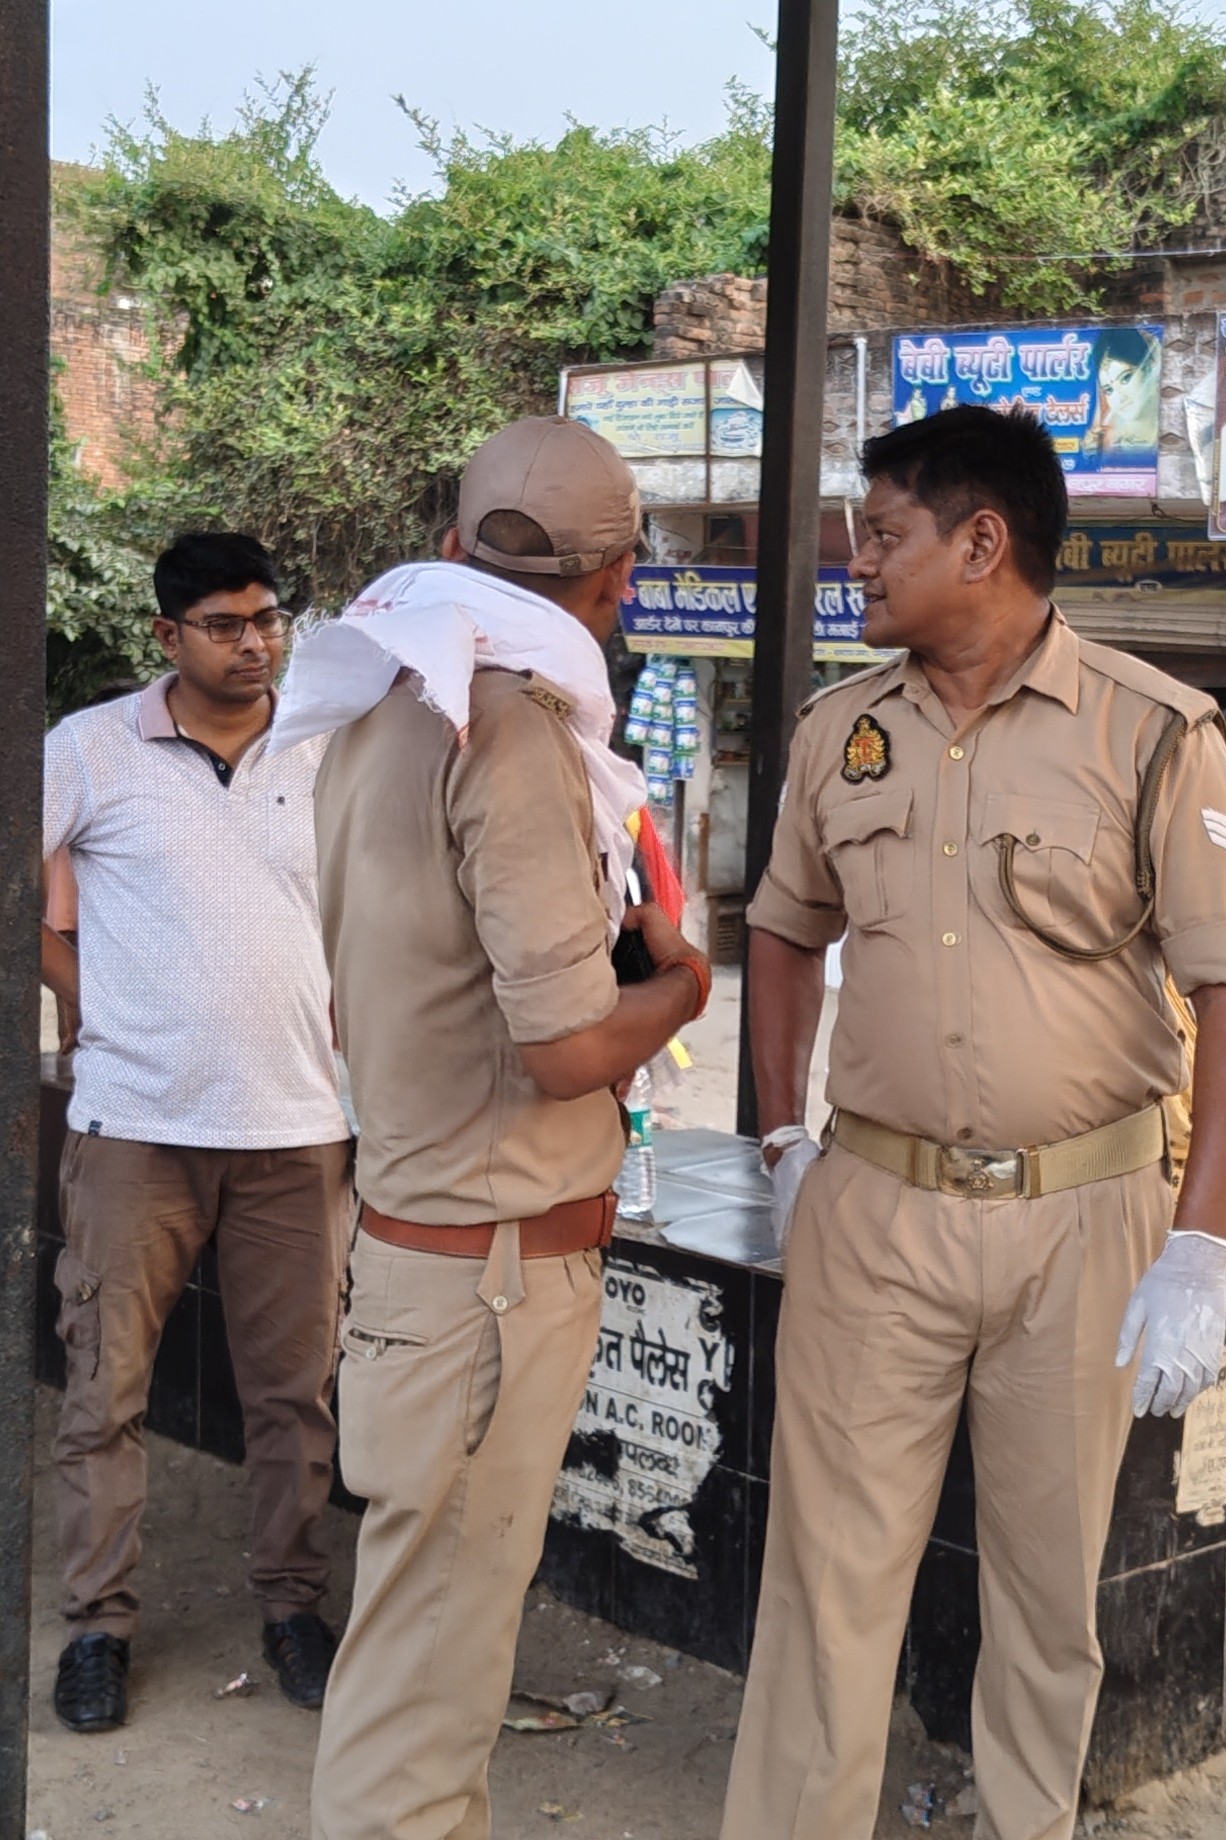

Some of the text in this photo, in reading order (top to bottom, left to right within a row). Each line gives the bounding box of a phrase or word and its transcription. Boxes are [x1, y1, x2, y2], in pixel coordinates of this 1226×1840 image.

[1018, 333, 1093, 381] पार्लर
[604, 1274, 646, 1307] OYO
[629, 1318, 692, 1394] पैलेस
[605, 1396, 645, 1431] A.C.
